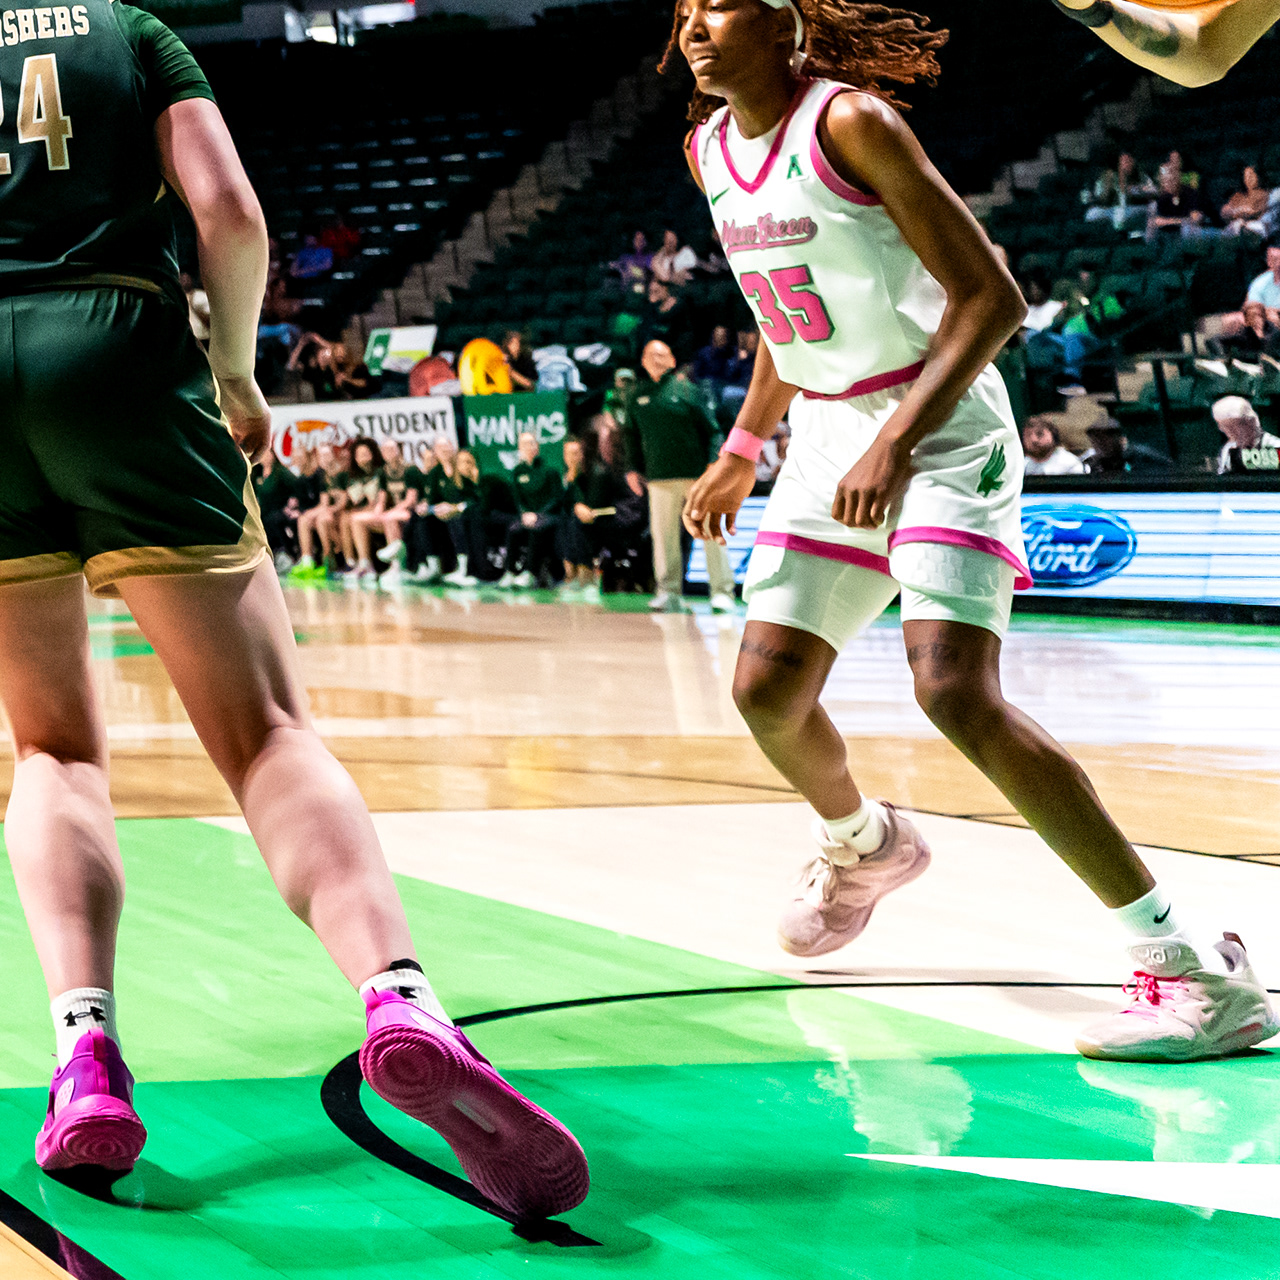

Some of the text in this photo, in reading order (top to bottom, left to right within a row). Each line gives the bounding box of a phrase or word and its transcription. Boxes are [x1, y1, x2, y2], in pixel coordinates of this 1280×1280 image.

[739, 263, 836, 345] 35
[352, 410, 449, 437] STUDENT
[1022, 517, 1105, 575] Ford
